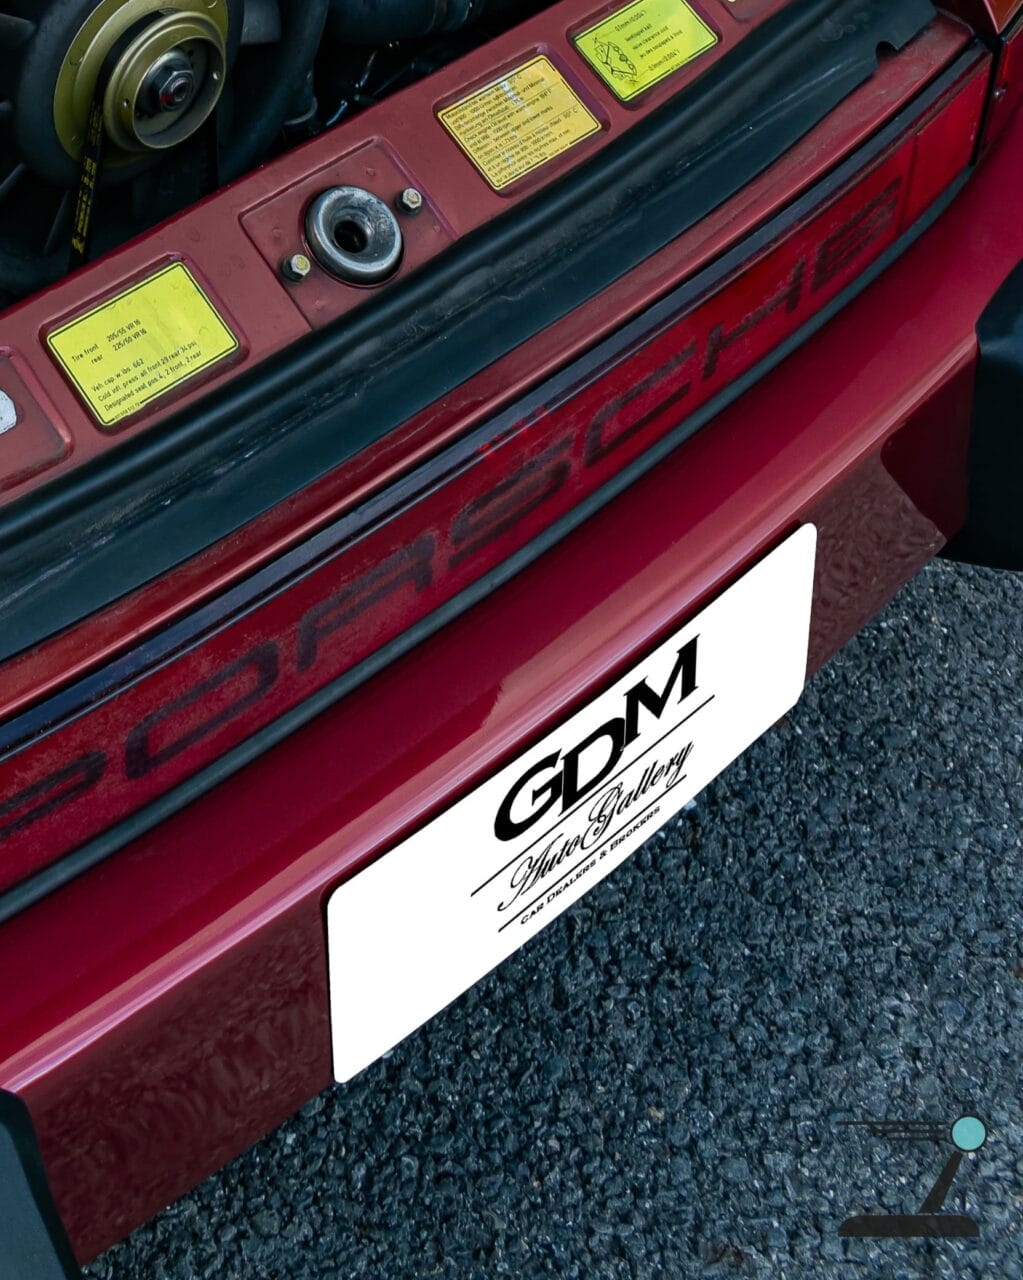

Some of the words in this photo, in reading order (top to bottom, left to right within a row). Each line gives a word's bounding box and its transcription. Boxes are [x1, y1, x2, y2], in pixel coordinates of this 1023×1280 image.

[82, 342, 99, 355] front
[167, 349, 181, 360] rear
[189, 350, 202, 360] rear
[89, 353, 104, 364] rear
[494, 633, 700, 841] GDM
[497, 833, 581, 911] Auto
[580, 741, 694, 850] Gallery
[521, 902, 544, 924] CAR
[546, 859, 596, 905] DEALERS
[609, 805, 662, 851] BROKERS
